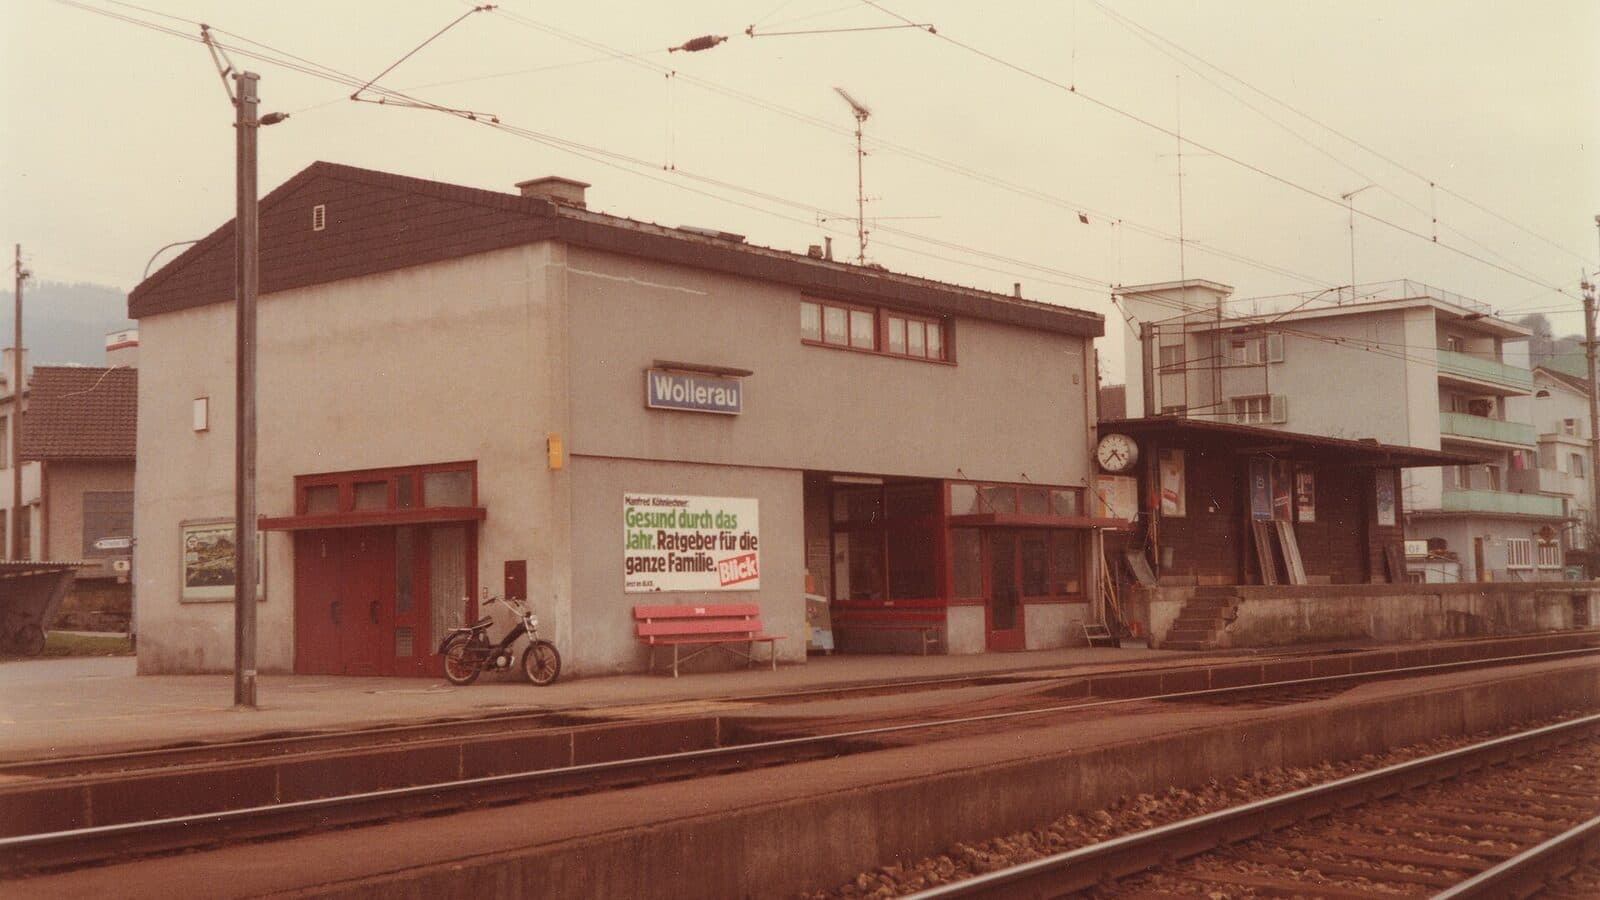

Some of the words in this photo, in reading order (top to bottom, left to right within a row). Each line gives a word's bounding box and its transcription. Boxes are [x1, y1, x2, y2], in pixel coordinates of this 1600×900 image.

[654, 375, 737, 407] Wollerau
[625, 507, 676, 529] Gesund
[678, 508, 713, 529] durch
[715, 509, 738, 530] das
[626, 529, 656, 550] Jahr.
[657, 530, 717, 553] Ratgeber
[719, 531, 737, 551] für
[739, 531, 758, 551] die
[626, 555, 666, 576] ganze
[668, 552, 717, 573] Familie.
